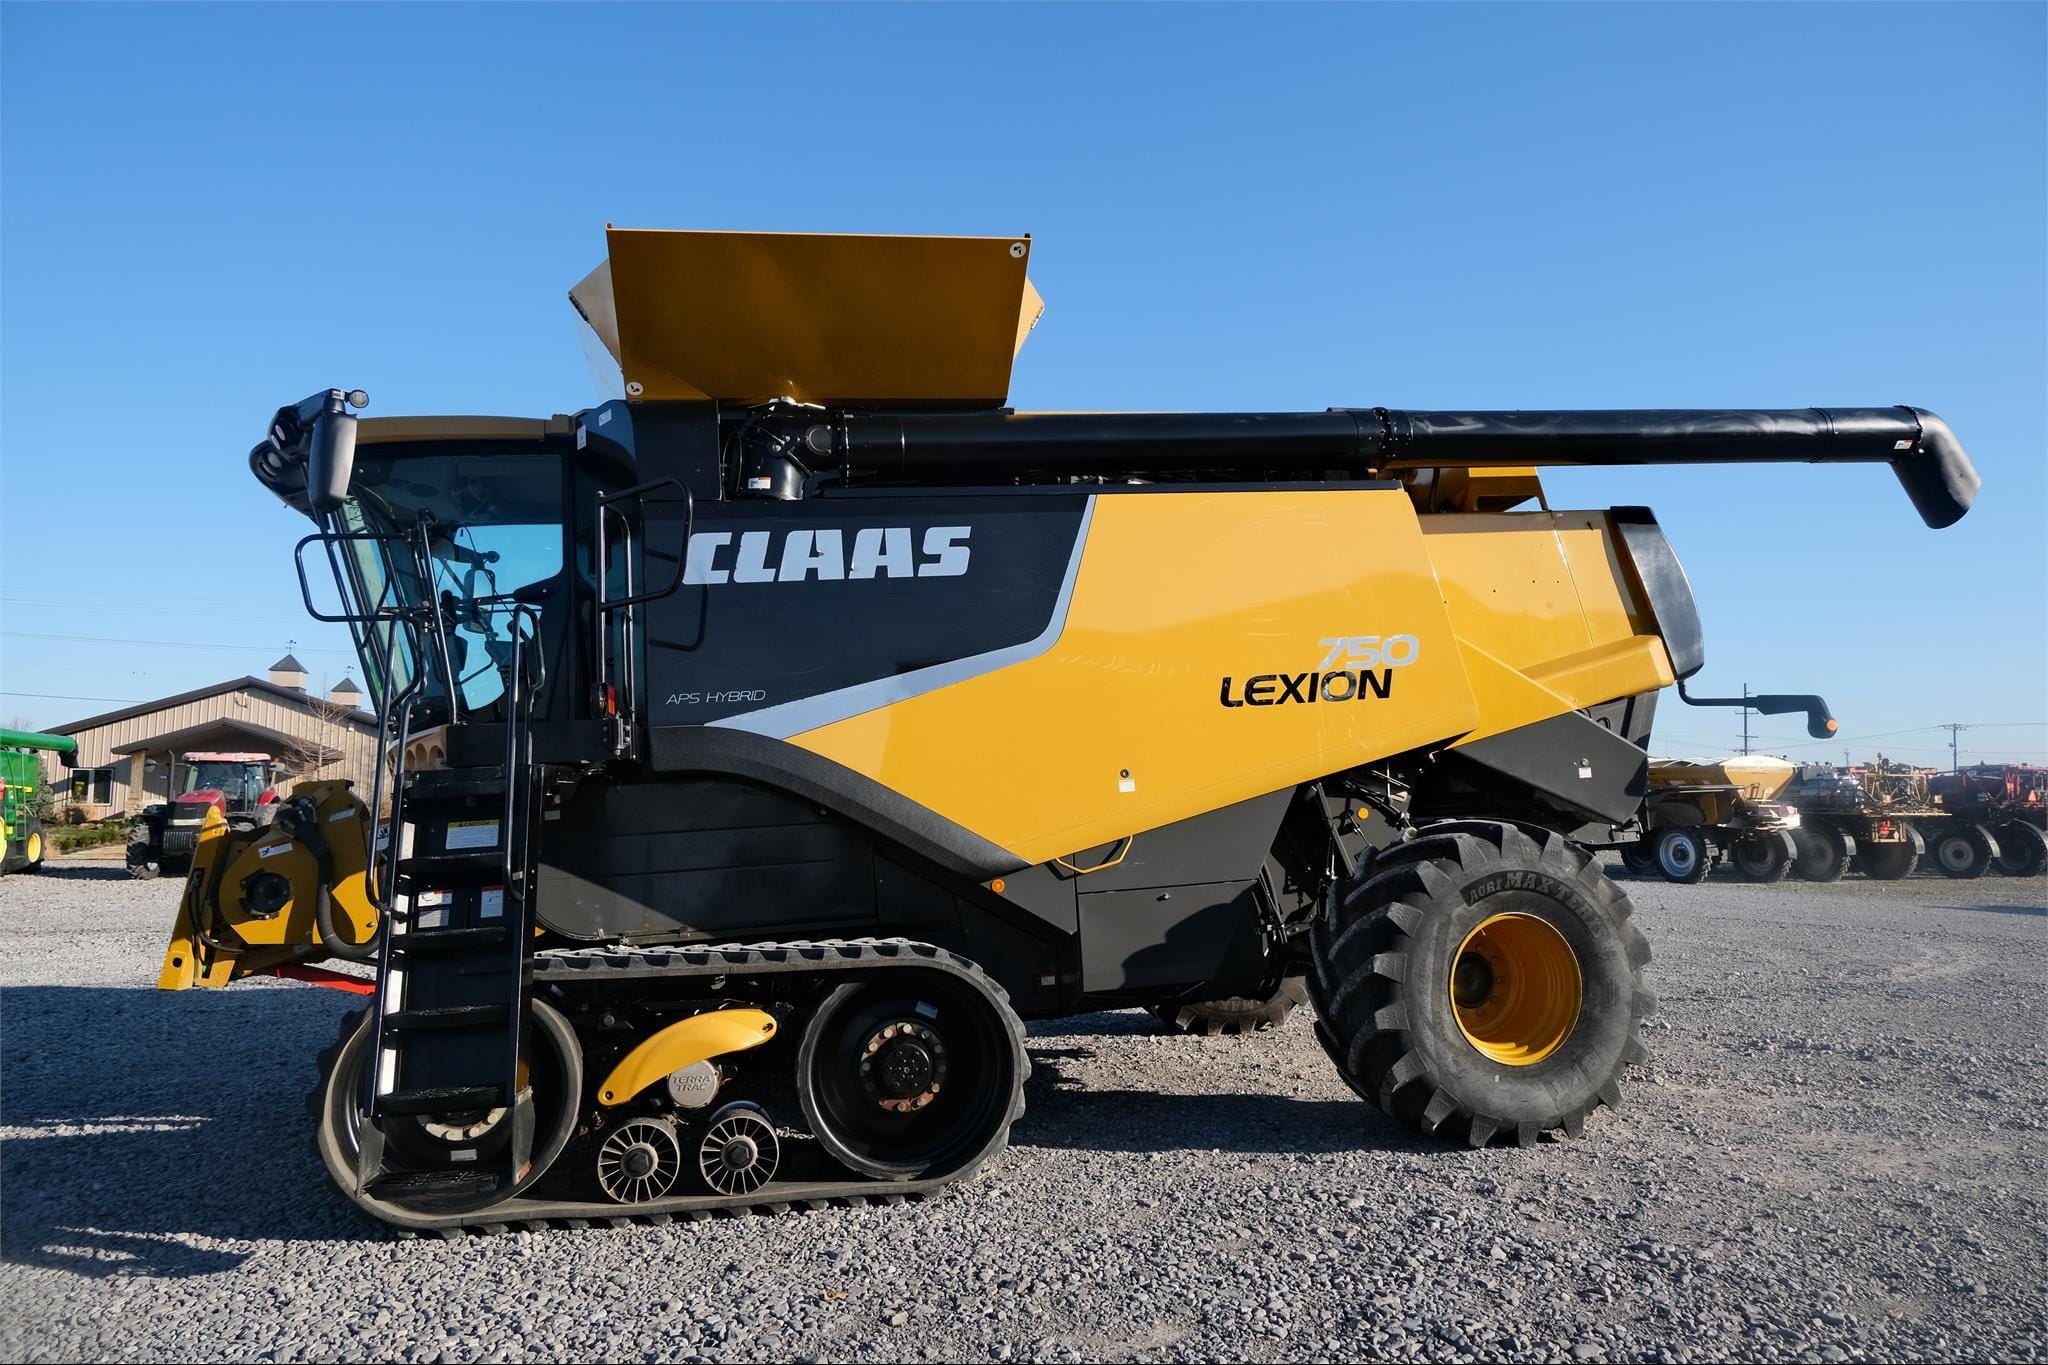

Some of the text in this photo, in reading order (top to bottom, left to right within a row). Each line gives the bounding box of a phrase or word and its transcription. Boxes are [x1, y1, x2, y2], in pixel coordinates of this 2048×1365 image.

[682, 526, 972, 585] CLAAS
[1318, 634, 1420, 670] 750
[666, 689, 766, 705] APS HYBRID
[1220, 668, 1393, 708] LEXION
[673, 1075, 711, 1084] TERRA
[677, 1083, 707, 1092] TRAC
